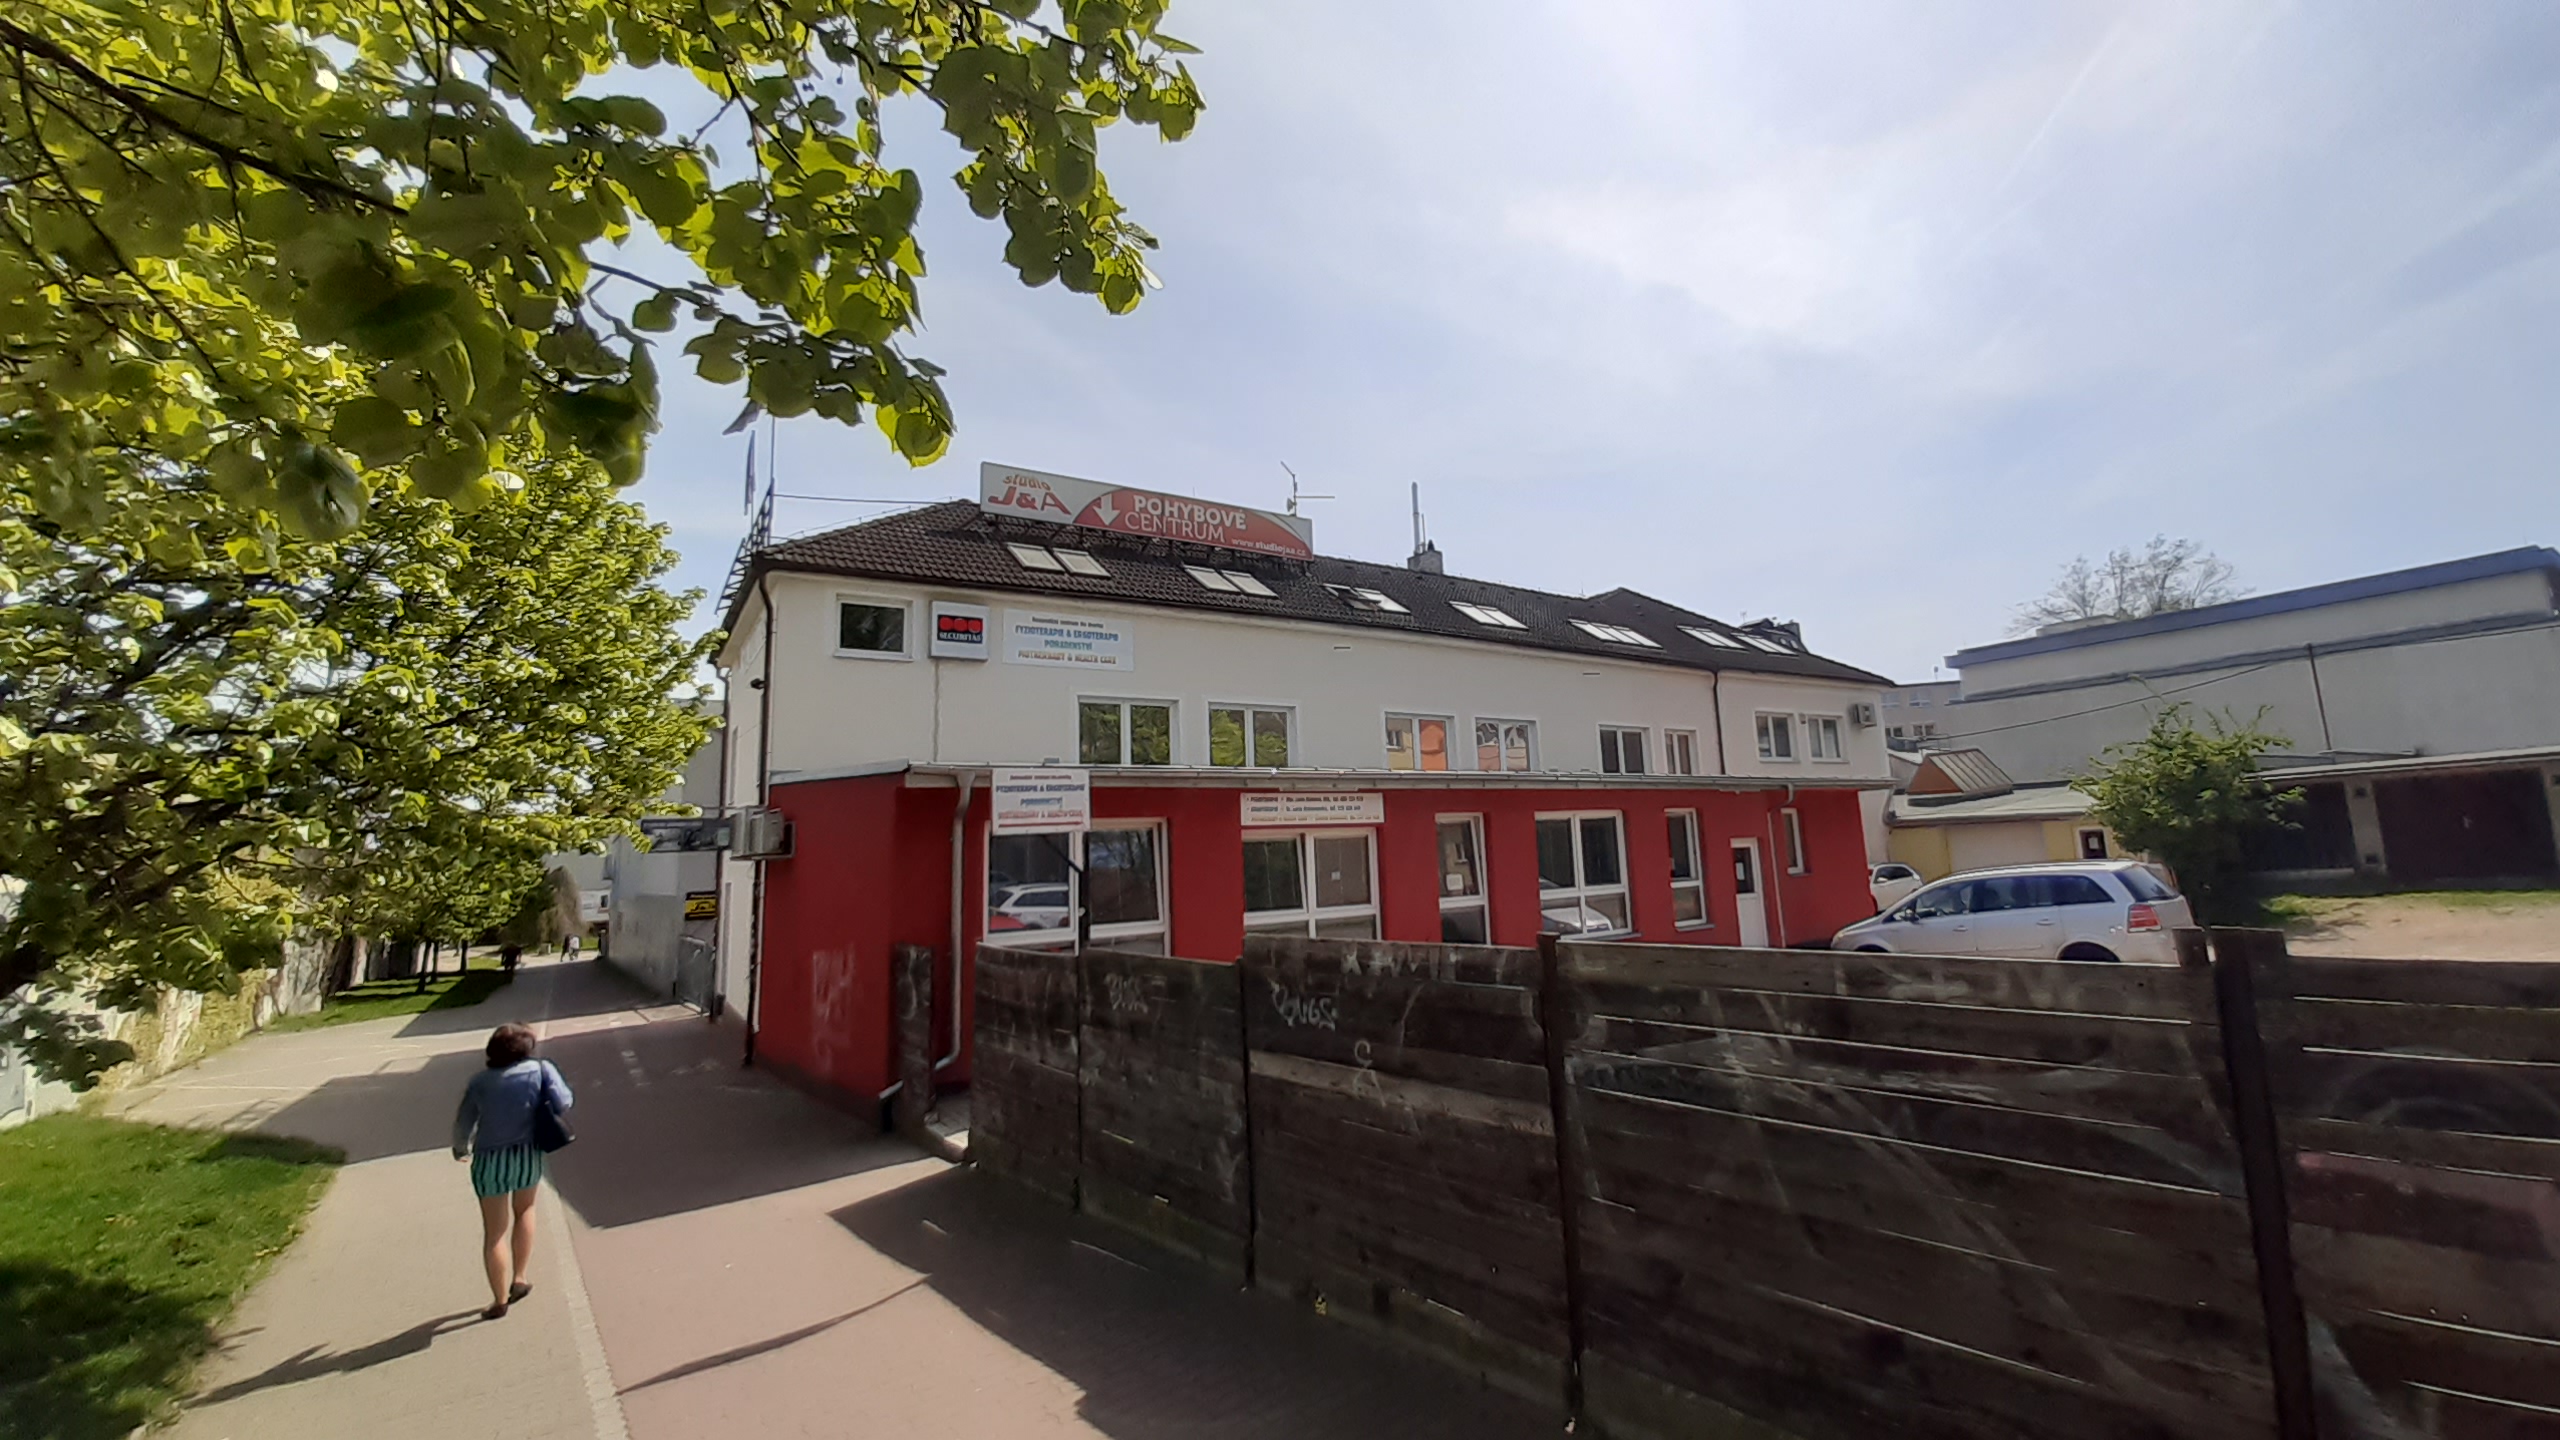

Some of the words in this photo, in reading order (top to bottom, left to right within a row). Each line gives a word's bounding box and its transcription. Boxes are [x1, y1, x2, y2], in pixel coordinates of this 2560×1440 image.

[1003, 474, 1051, 491] studio
[987, 486, 1072, 516] J&A
[1133, 494, 1247, 530] POHYBOVÉ
[1125, 511, 1226, 543] CENTRUM
[939, 632, 982, 642] SECURITAS
[1066, 629, 1072, 638] &
